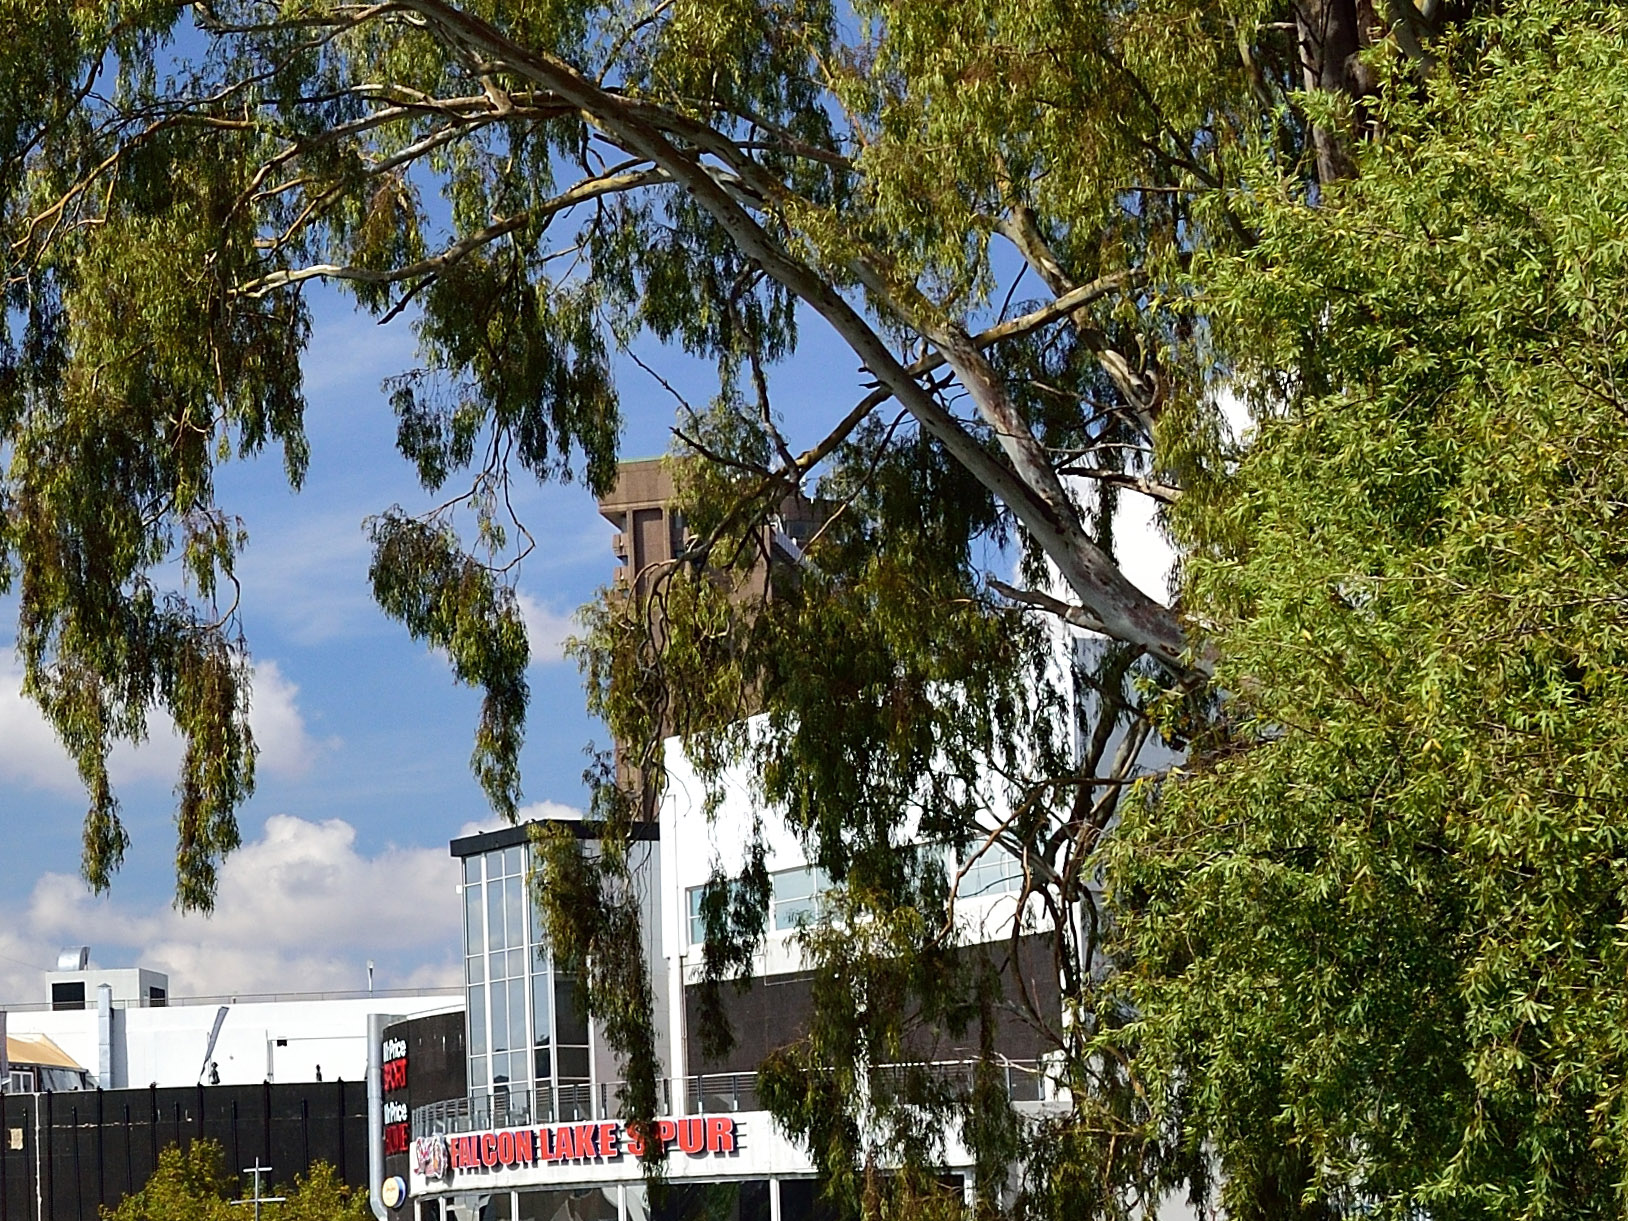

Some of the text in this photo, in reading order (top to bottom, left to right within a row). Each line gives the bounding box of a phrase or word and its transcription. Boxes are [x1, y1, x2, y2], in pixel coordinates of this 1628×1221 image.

[450, 1117, 734, 1169] FALCON LAKE SPUR
